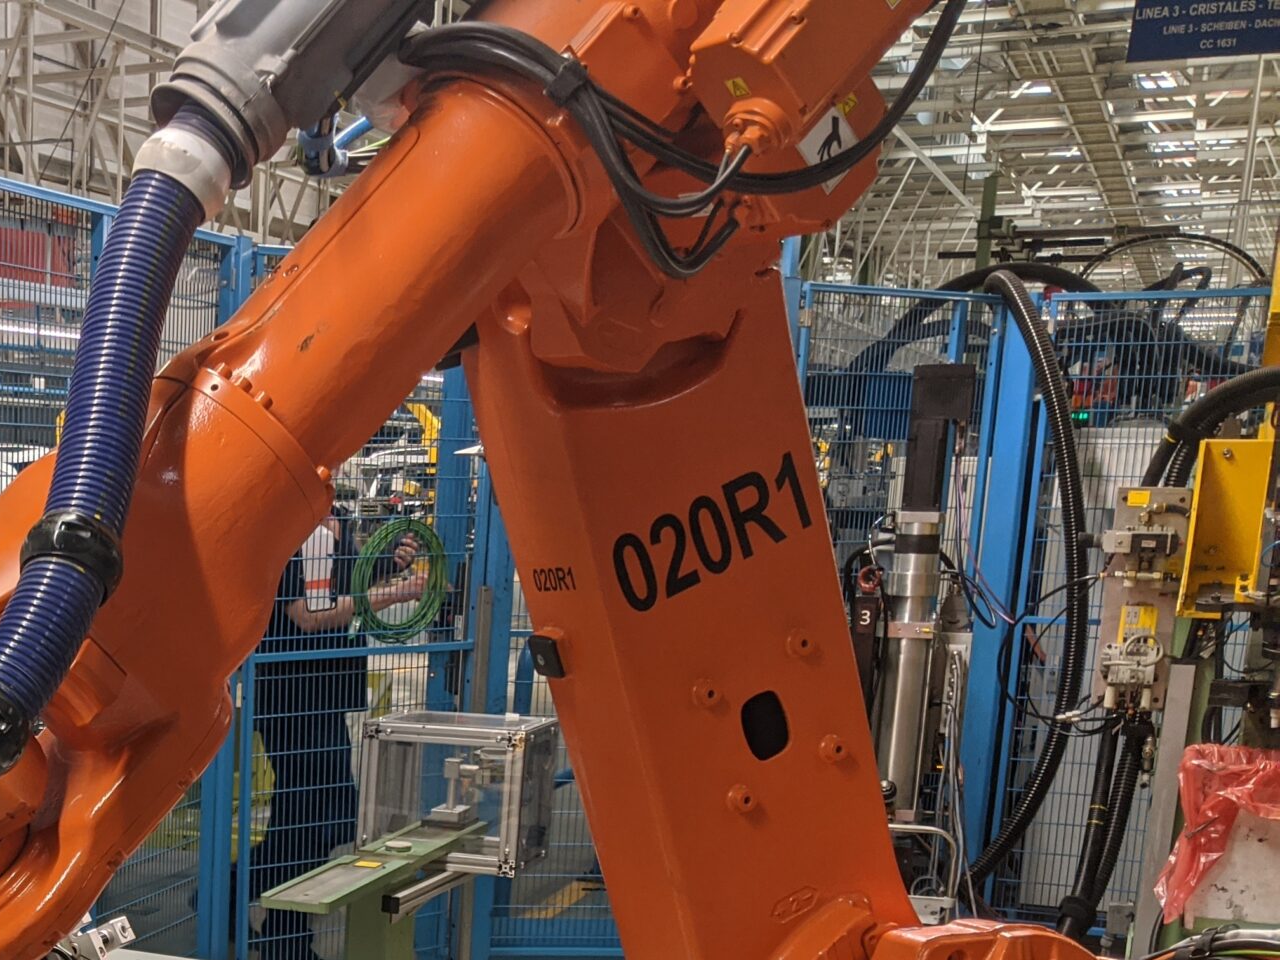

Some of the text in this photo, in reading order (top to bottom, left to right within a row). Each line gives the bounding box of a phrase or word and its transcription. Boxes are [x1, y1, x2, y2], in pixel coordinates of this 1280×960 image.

[1135, 6, 1169, 20] LINEA
[1172, 5, 1180, 17] 3
[1189, 0, 1256, 16] CRISTALES
[1163, 24, 1186, 35] LINIE
[1187, 23, 1194, 33] 3
[1200, 20, 1247, 33] SCHEIBEN
[1200, 37, 1237, 49] CC 1631
[612, 450, 813, 613] 020R1
[532, 567, 577, 592] 020R1
[860, 609, 871, 625] 3
